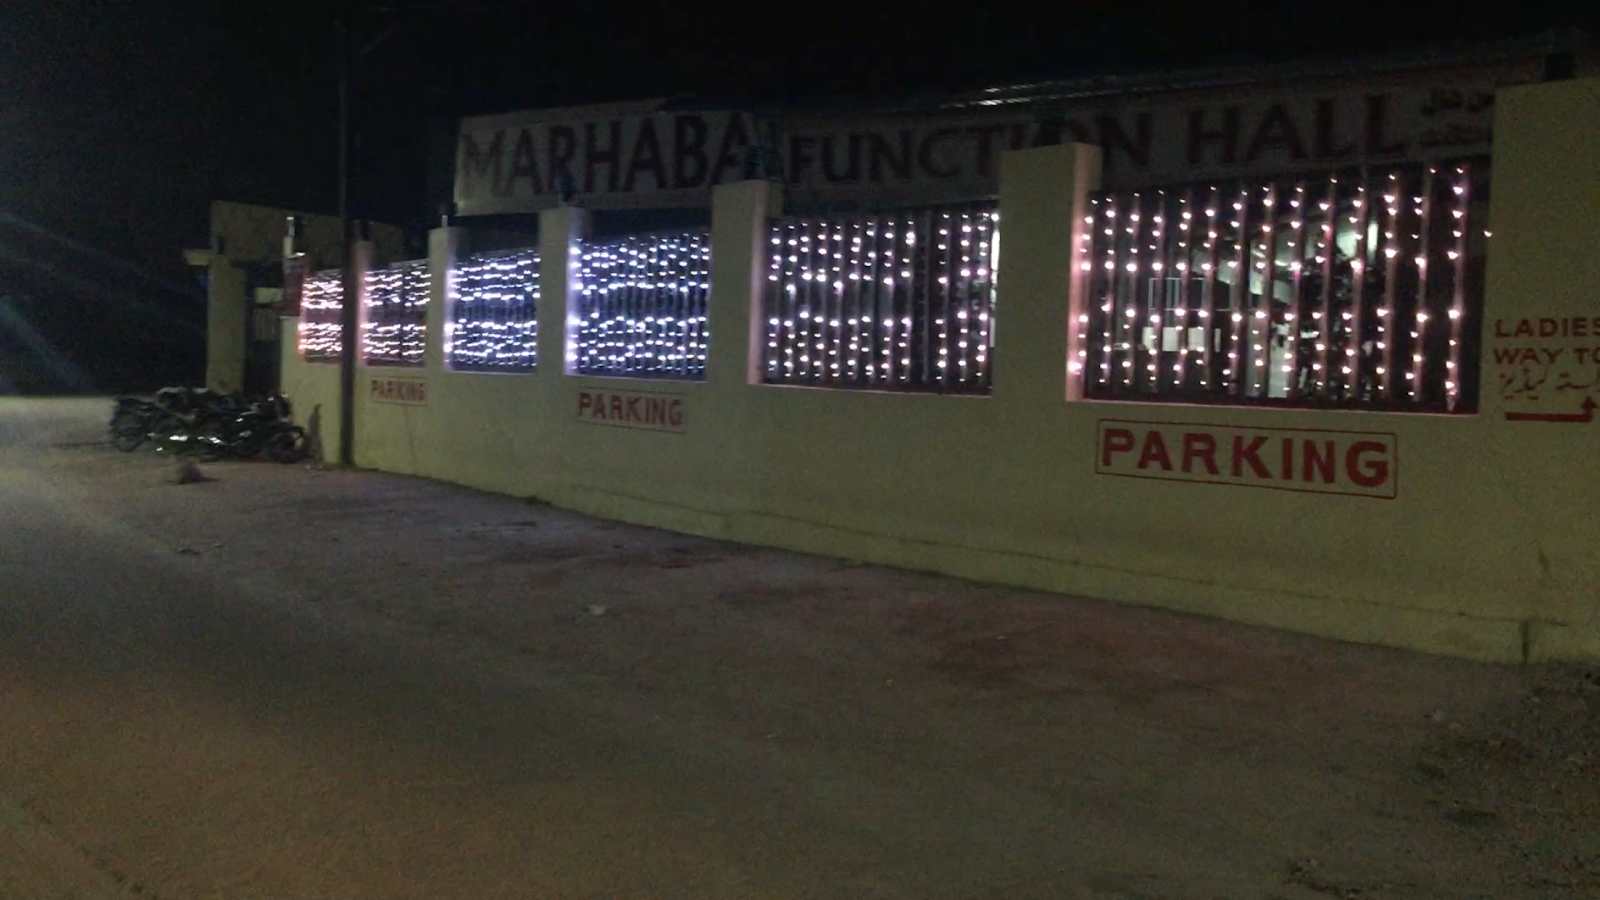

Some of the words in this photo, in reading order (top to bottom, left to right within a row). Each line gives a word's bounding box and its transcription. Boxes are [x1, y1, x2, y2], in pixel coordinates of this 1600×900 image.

[459, 110, 756, 197] MARHABA
[1184, 92, 1402, 165] HALL
[1493, 347, 1564, 365] WAY
[370, 379, 427, 402] PARKING
[578, 392, 683, 426] PARKING
[1101, 427, 1390, 488] PARKING
